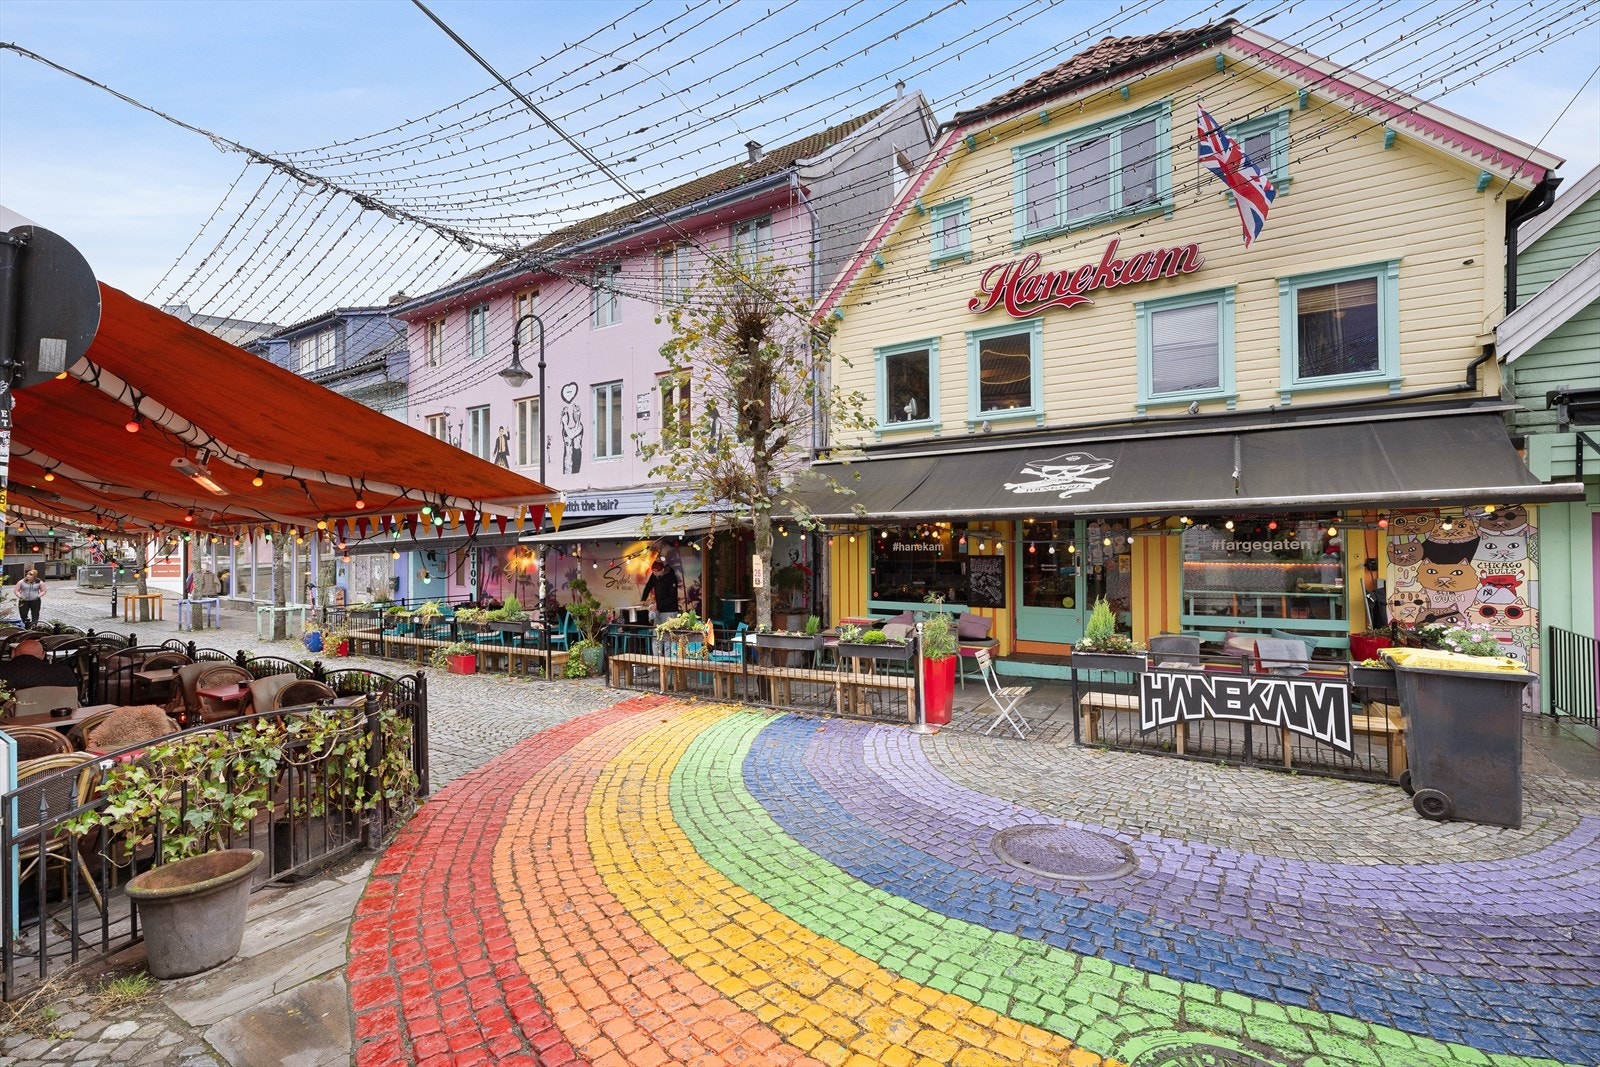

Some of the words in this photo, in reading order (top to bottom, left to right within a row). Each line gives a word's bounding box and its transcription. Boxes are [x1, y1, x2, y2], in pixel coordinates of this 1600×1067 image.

[967, 237, 1205, 318] Hanekam
[581, 499, 596, 511] the
[597, 498, 619, 511] hair?
[892, 542, 945, 552] #hanekam
[1211, 538, 1312, 553] #fargegaten
[1432, 594, 1465, 603] GUCCI
[1140, 672, 1352, 751] HANEKAM
